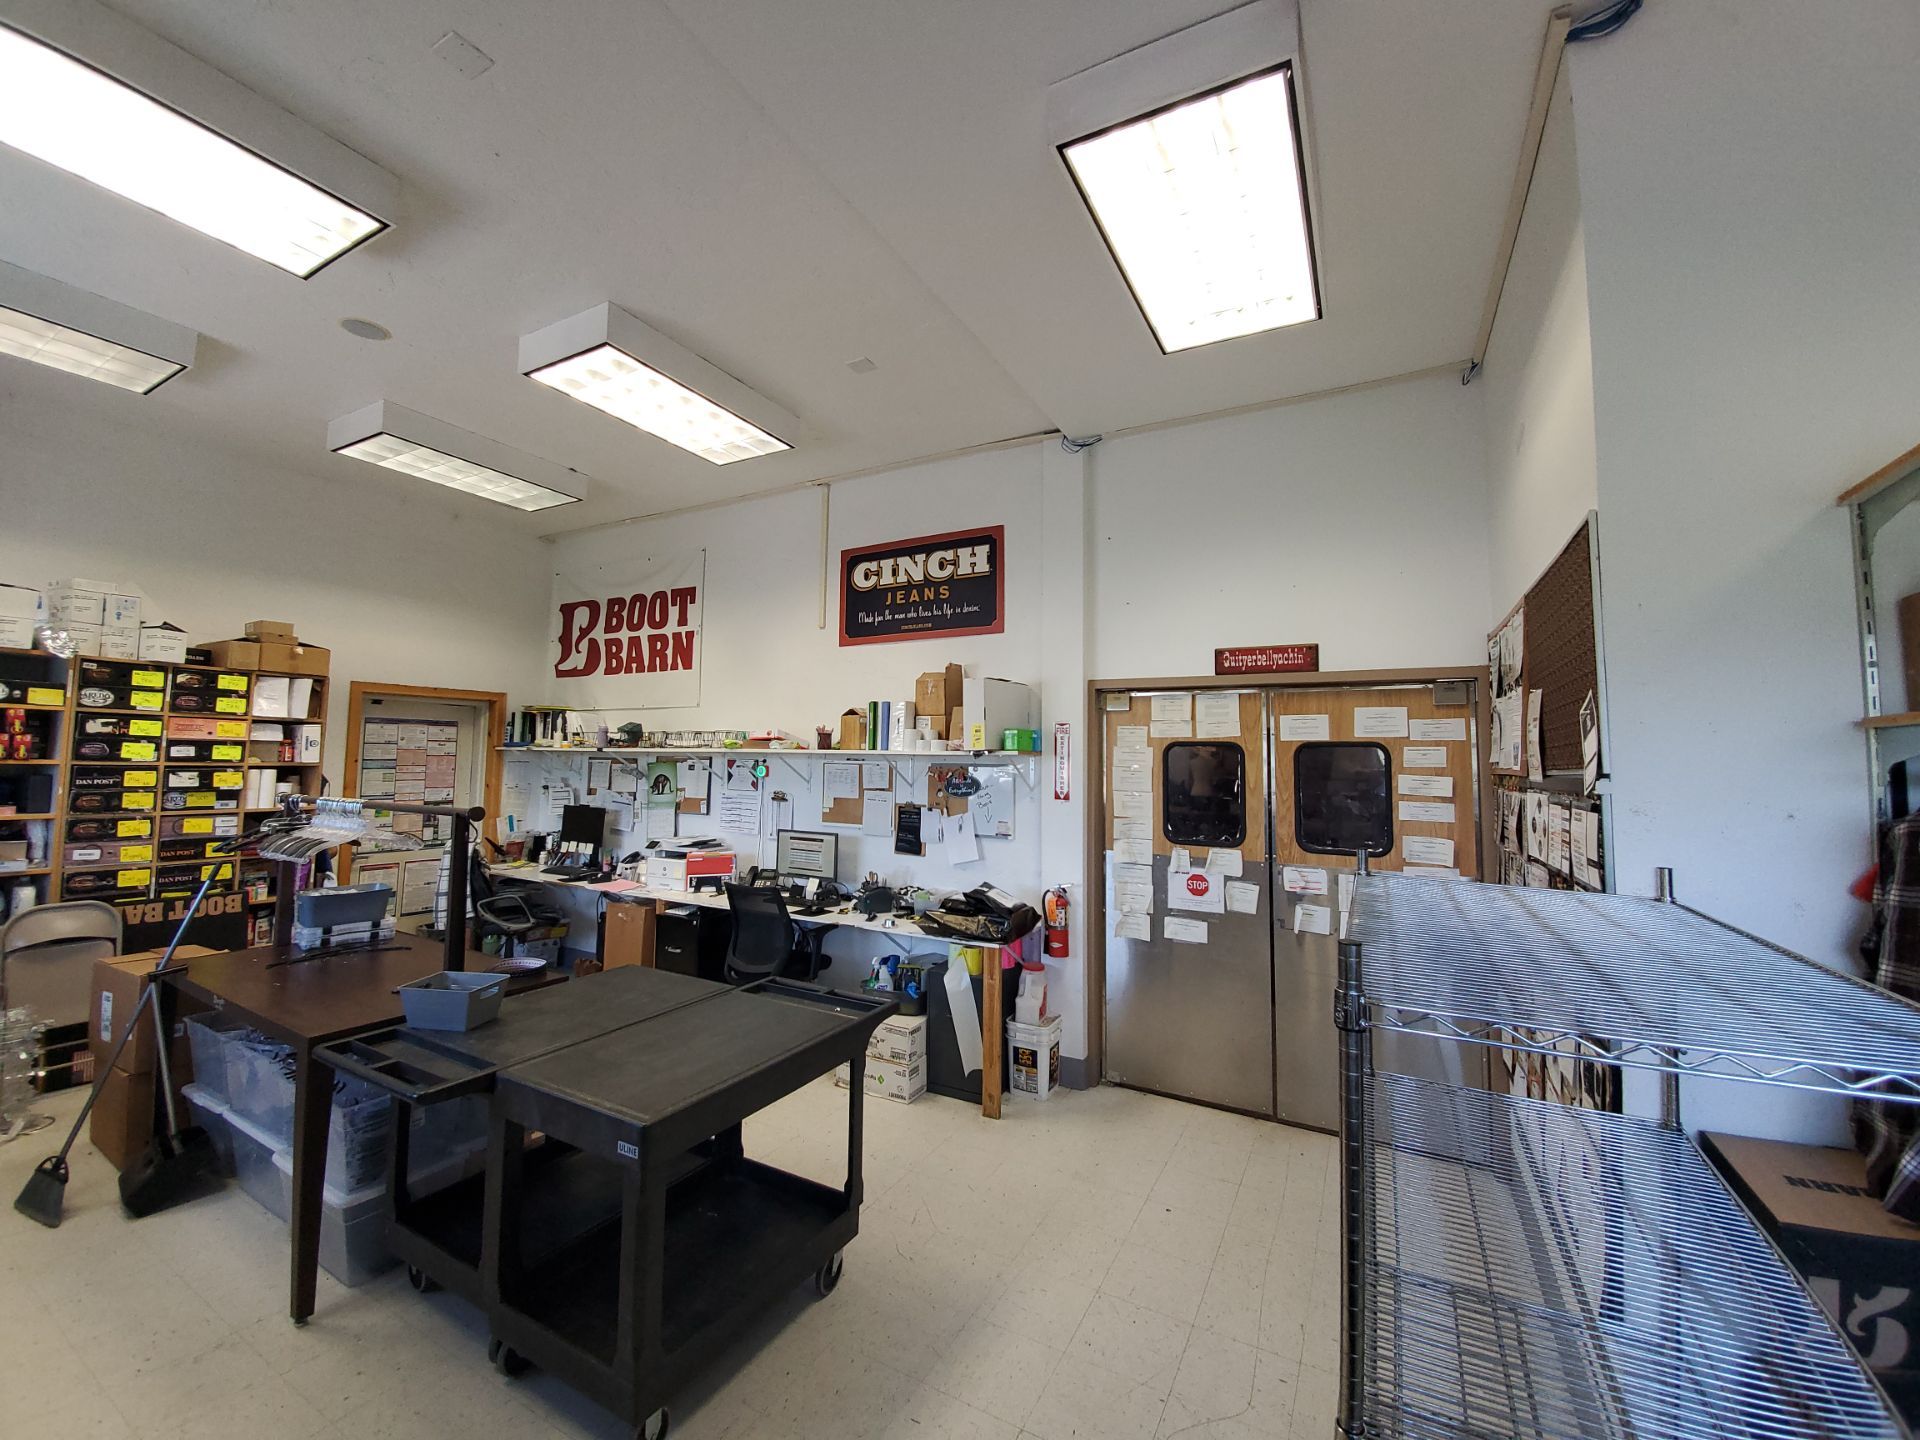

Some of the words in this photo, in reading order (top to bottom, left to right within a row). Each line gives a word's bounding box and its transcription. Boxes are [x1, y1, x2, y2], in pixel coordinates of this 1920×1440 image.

[852, 544, 990, 591] CINCH
[885, 585, 950, 605] JEANS
[604, 586, 697, 634] BOOT
[858, 610, 873, 624] Made
[874, 610, 884, 626] for
[884, 609, 892, 621] the
[894, 612, 906, 620] man
[907, 606, 918, 619] who
[919, 605, 932, 617] lives
[933, 604, 942, 616] his
[943, 602, 954, 621] life
[955, 606, 961, 614] in
[604, 631, 694, 675] BARN
[1187, 880, 1208, 890] STOP
[619, 1143, 637, 1157] ULINE
